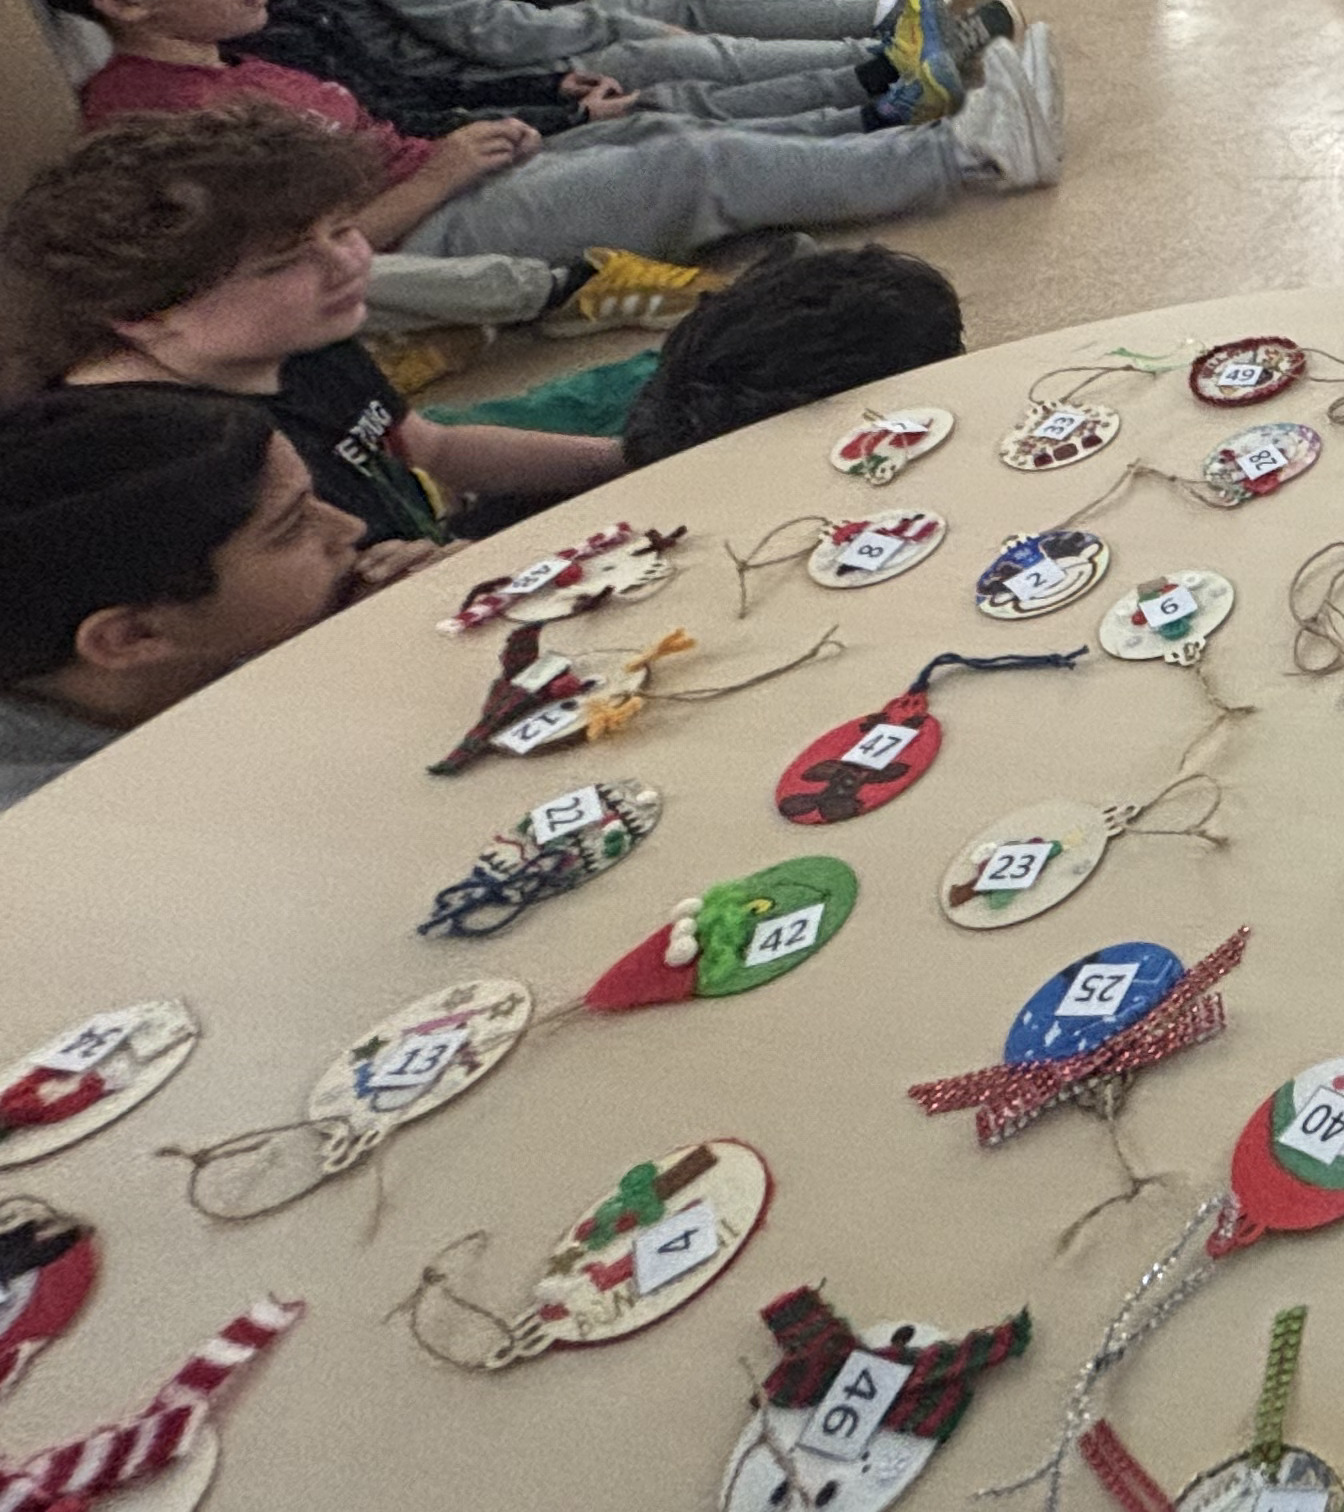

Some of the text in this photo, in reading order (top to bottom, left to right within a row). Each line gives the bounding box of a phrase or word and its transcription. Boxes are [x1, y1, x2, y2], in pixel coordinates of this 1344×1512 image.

[1226, 369, 1255, 381] 49
[1044, 417, 1075, 434] 33
[1249, 450, 1277, 470] 28
[858, 545, 884, 558] 8
[1027, 573, 1047, 587] 2
[514, 714, 559, 741] 12
[860, 735, 902, 757] 47
[546, 797, 584, 832] 22
[989, 855, 1036, 880] 23
[759, 919, 808, 951] 42
[1075, 975, 1126, 1002] 25
[387, 1044, 448, 1075] 13
[657, 1228, 699, 1255] 4
[822, 1368, 877, 1438] 46
